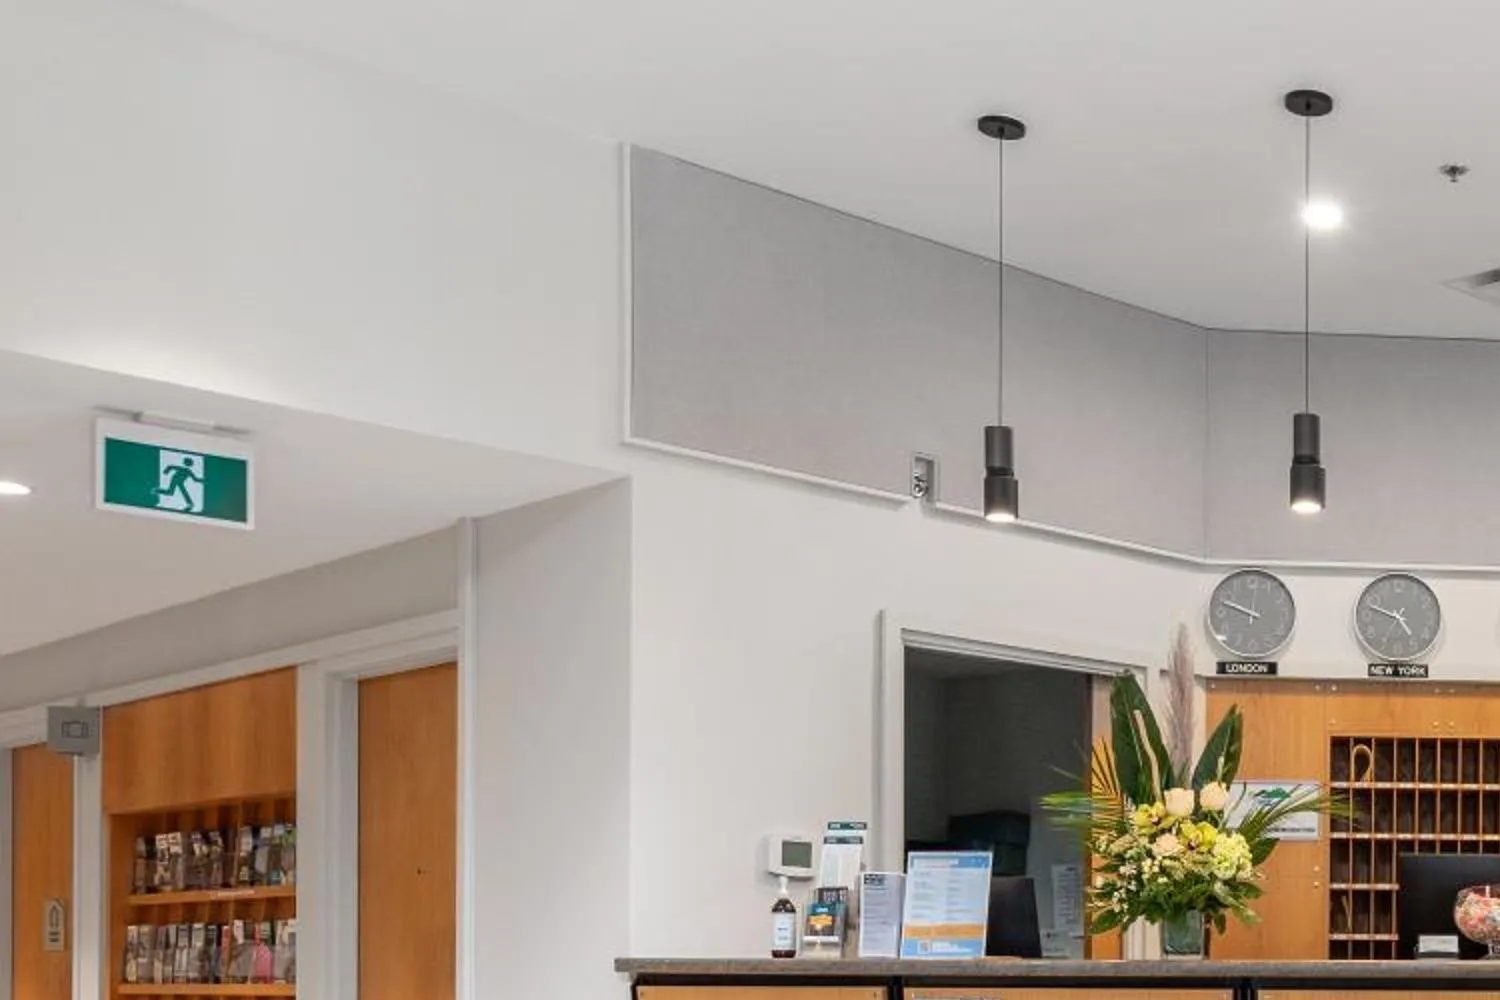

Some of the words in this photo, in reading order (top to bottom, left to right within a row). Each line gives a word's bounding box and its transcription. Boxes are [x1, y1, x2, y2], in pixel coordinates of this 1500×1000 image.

[1224, 663, 1269, 674] LONDON
[1370, 665, 1393, 675] NEW
[1398, 665, 1426, 677] YORK
